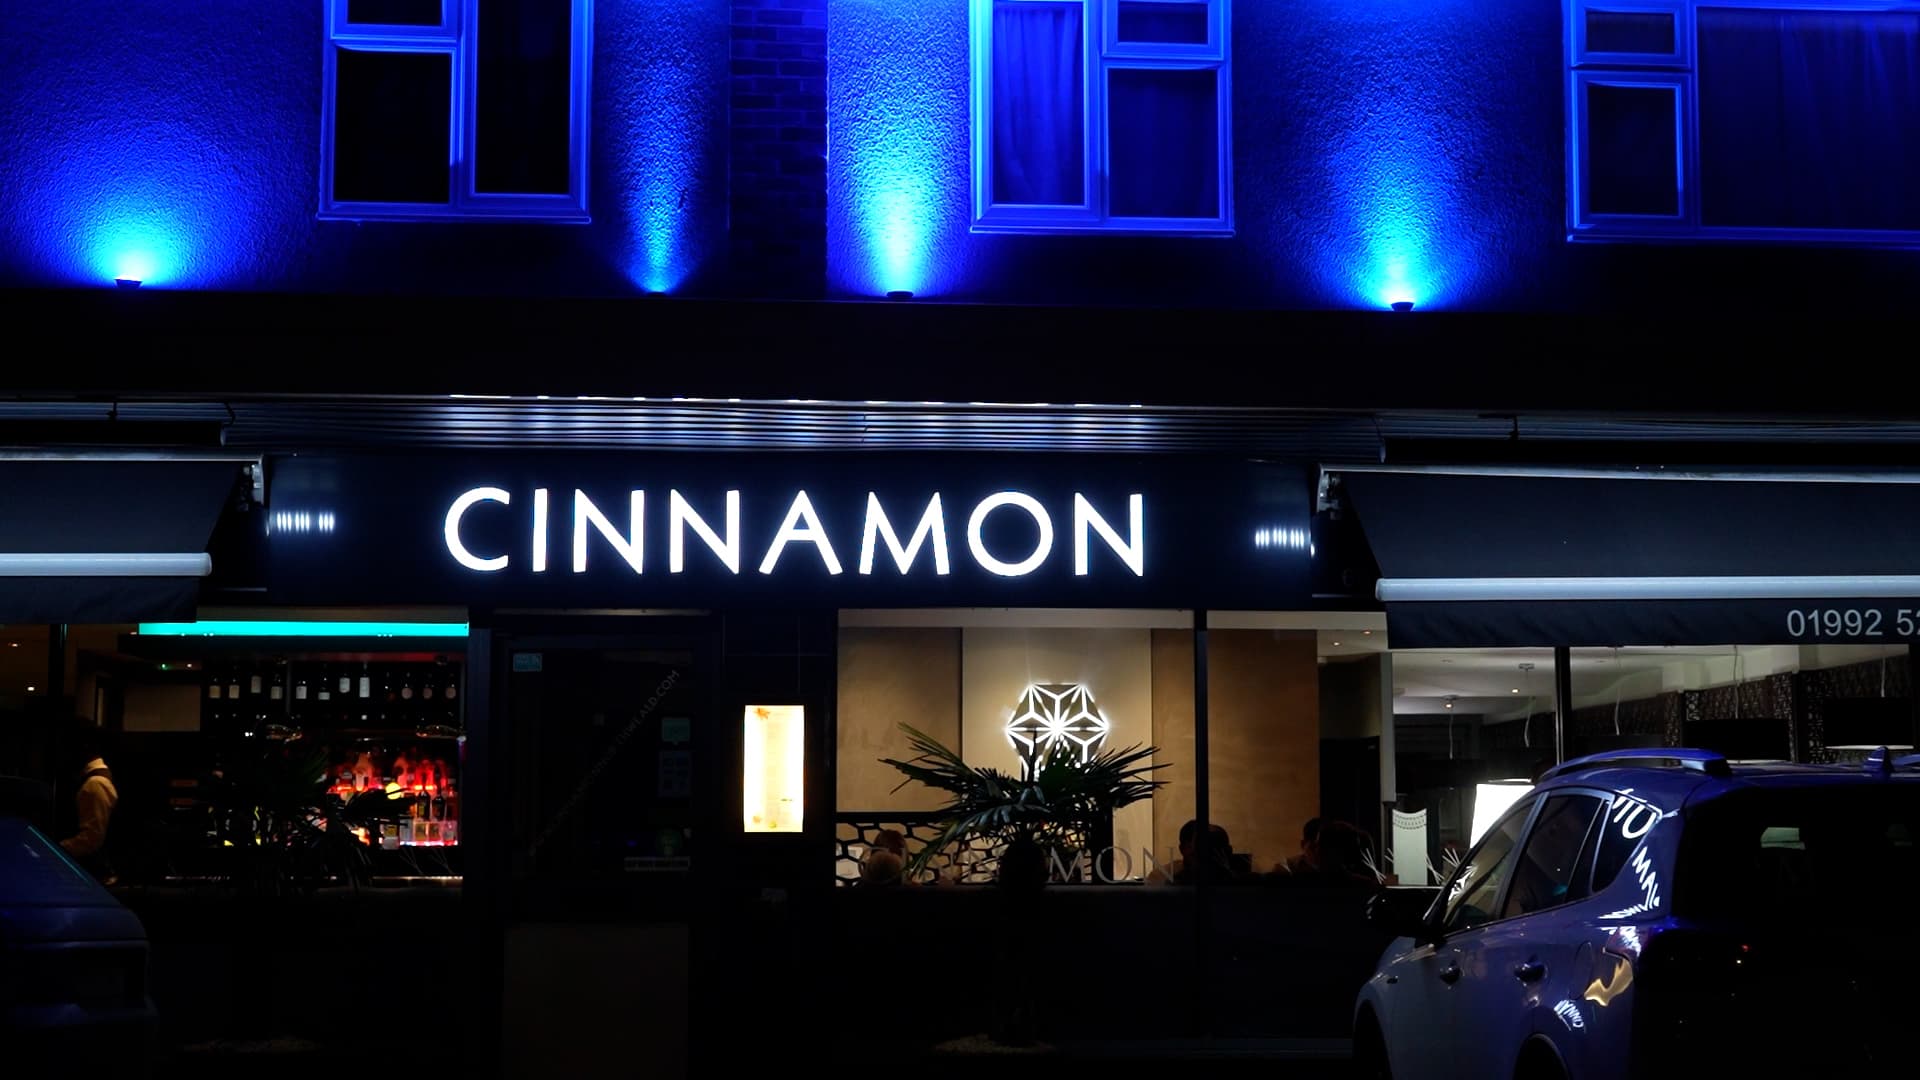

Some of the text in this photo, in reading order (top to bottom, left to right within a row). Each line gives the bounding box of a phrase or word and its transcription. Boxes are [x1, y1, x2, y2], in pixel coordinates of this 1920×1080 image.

[444, 487, 1144, 576] CINNAMON
[1786, 608, 1920, 637] 01992 5
